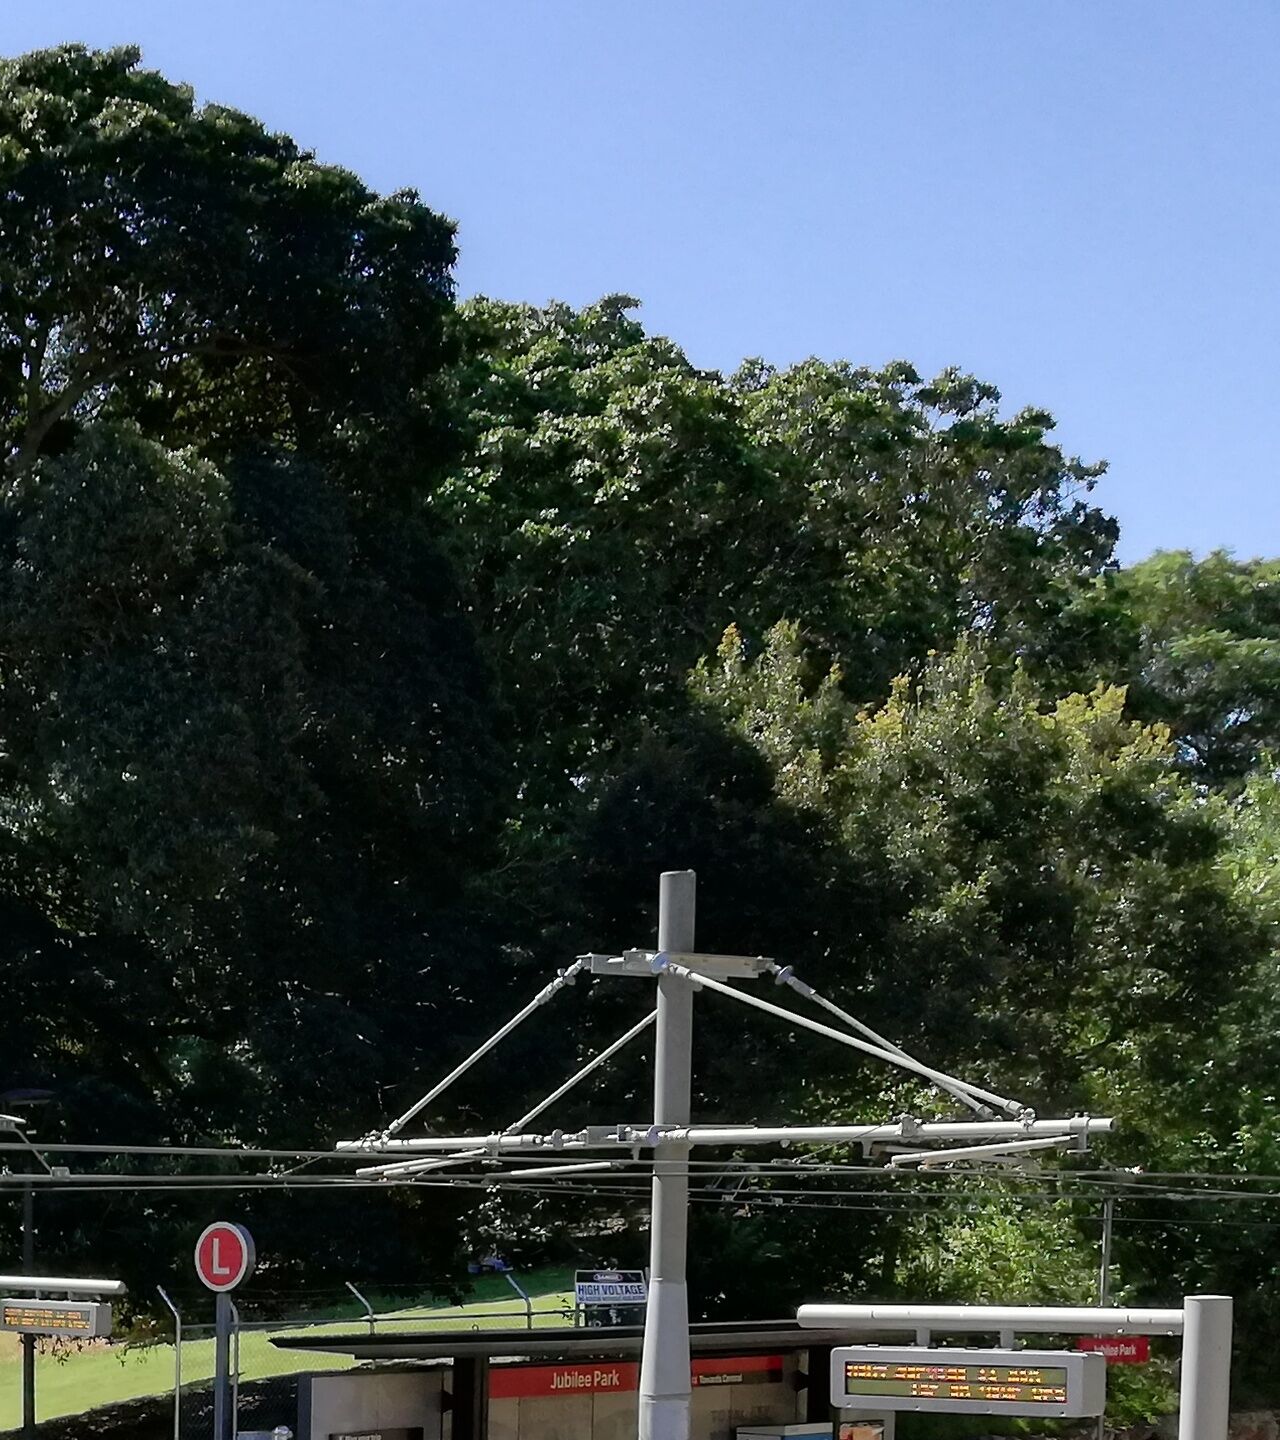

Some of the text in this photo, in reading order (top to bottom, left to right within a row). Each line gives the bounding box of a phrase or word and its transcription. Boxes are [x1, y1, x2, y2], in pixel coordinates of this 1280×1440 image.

[213, 1238, 230, 1274] L
[578, 1284, 644, 1296] HIGH VOLTAGE
[1120, 1344, 1137, 1356] Park
[550, 1370, 620, 1389] Jubilee Park
